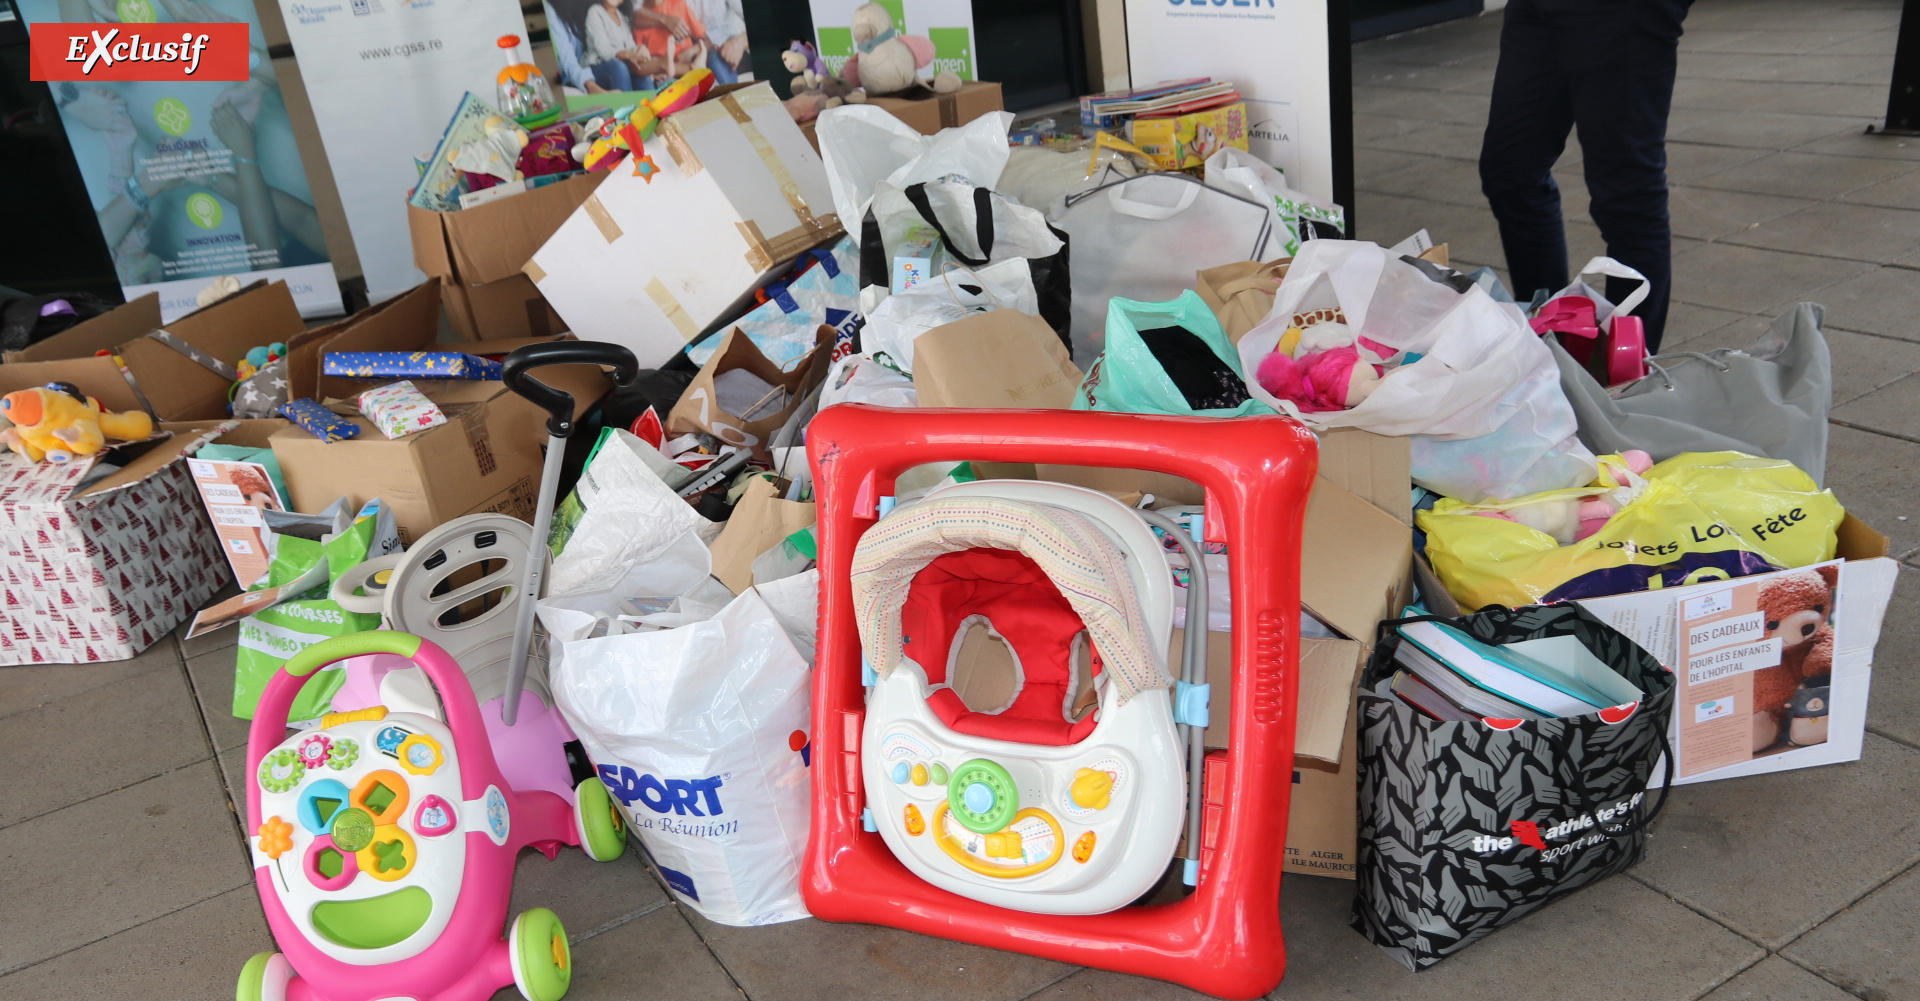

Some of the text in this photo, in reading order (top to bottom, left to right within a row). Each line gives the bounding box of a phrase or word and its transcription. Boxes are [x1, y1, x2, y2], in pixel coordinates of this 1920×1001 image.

[359, 39, 443, 60] www.cgss.re
[934, 58, 966, 73] mgen
[1249, 131, 1290, 142] ARTELIA
[187, 233, 242, 246] INNOVATION
[291, 284, 313, 294] ACUN
[216, 489, 240, 497] CADEAUX
[235, 508, 254, 516] ENFANTS
[1751, 508, 1808, 542] Fête
[288, 603, 344, 624] COURSES
[264, 632, 298, 652] JUMBO
[1690, 632, 1709, 645] DES
[1712, 619, 1760, 639] CADEAUX
[1690, 644, 1771, 670] POUR LES ENFANTS
[1690, 662, 1744, 683] DE L'HOPITAL
[597, 764, 724, 816] SPORT
[634, 813, 739, 838] La Réunion
[1472, 834, 1512, 853] the
[1544, 802, 1629, 840] athlete's
[1311, 850, 1344, 860] ALGER
[1540, 834, 1586, 862] sport
[1292, 858, 1356, 870] ILE MAURICE
